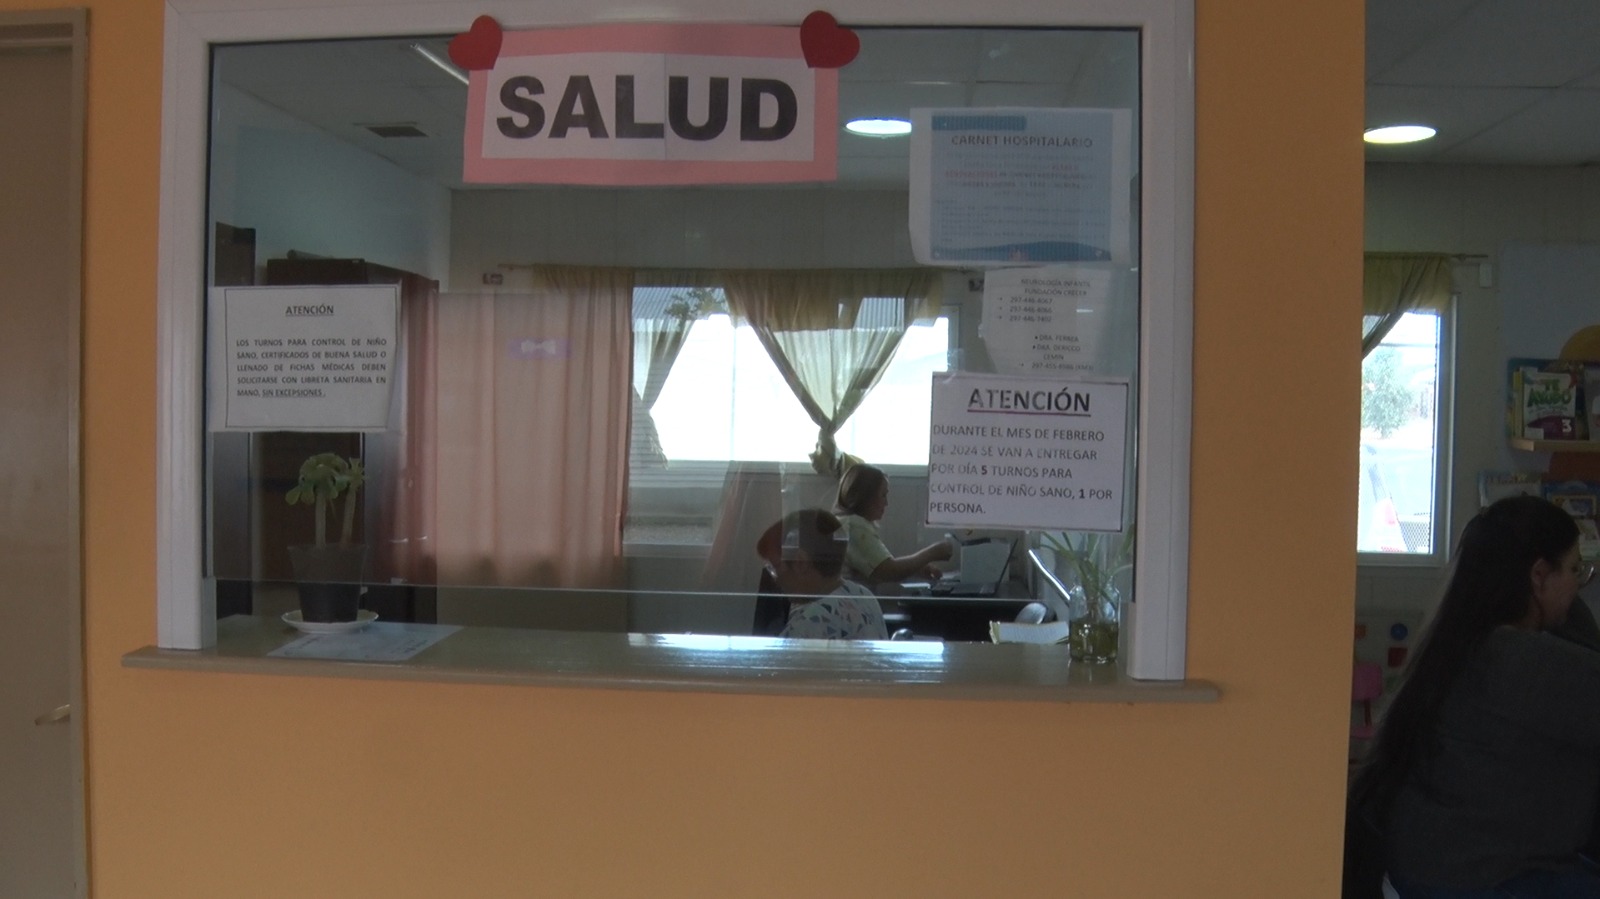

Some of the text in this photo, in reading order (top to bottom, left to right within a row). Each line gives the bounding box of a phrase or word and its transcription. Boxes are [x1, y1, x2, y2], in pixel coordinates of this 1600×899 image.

[496, 75, 798, 141] SALUD
[952, 135, 1093, 148] CARNET HOSPITALARIO
[285, 303, 334, 315] ATENCIÓN
[236, 339, 249, 347] LOS
[254, 339, 283, 347] TURNOS
[287, 338, 307, 346] PARA
[311, 338, 346, 346] CONTROL
[366, 336, 387, 346] NIÑO
[261, 351, 309, 359] CERTIFICADOS
[312, 351, 322, 359] DE
[324, 351, 350, 359] BUENA
[352, 350, 378, 359] SALUD
[380, 350, 387, 358] O
[237, 362, 387, 372] LLENADO DE FICHAS MÉDICAS DEBEN
[237, 376, 387, 385] SOLICITARSE CON LIBRETA SANITARIA EN
[262, 389, 274, 397] SIN
[968, 387, 1091, 412] ATENCIÓN
[1562, 419, 1572, 433] 3
[933, 425, 1105, 441] DURANTE EL MES DE FEBRERO
[932, 444, 1098, 461] DE 2024 SE VAN A ENTREGAR
[931, 461, 1073, 479] POR DÍA 5 TURNOS PARA
[930, 483, 1113, 500] CONTROL DE NIÑO SANO, 1 POR
[929, 501, 986, 514] PERSONA.
